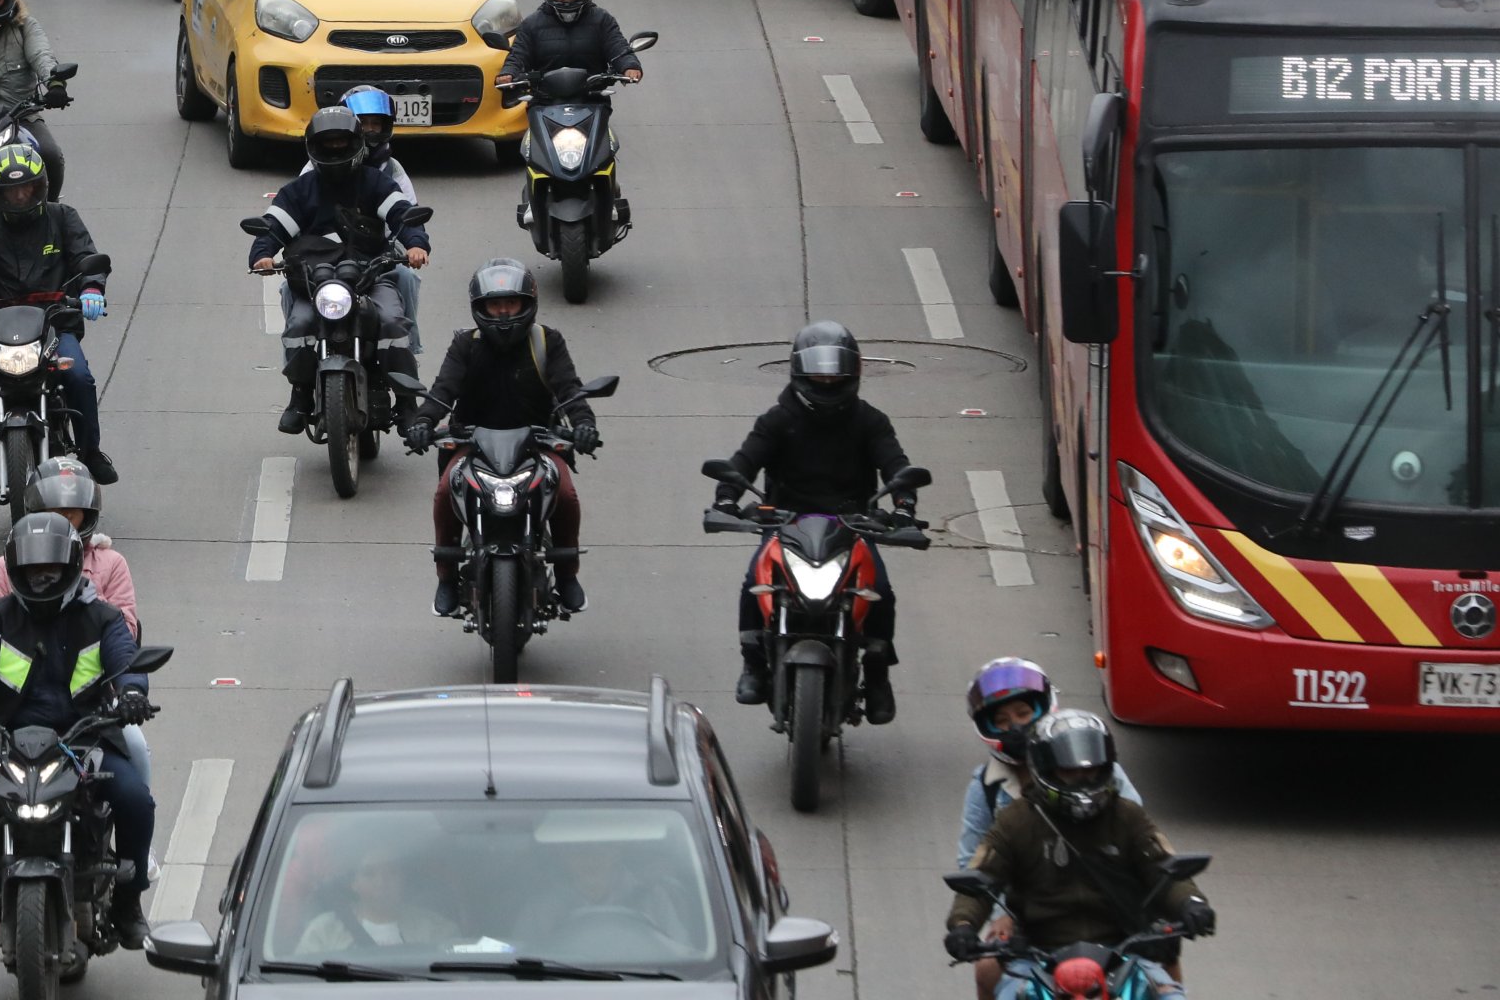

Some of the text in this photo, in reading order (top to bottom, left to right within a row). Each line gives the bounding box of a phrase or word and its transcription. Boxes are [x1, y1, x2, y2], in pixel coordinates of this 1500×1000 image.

[390, 36, 406, 44] KIA
[1282, 57, 1353, 100] B12
[1293, 668, 1367, 703] T1522
